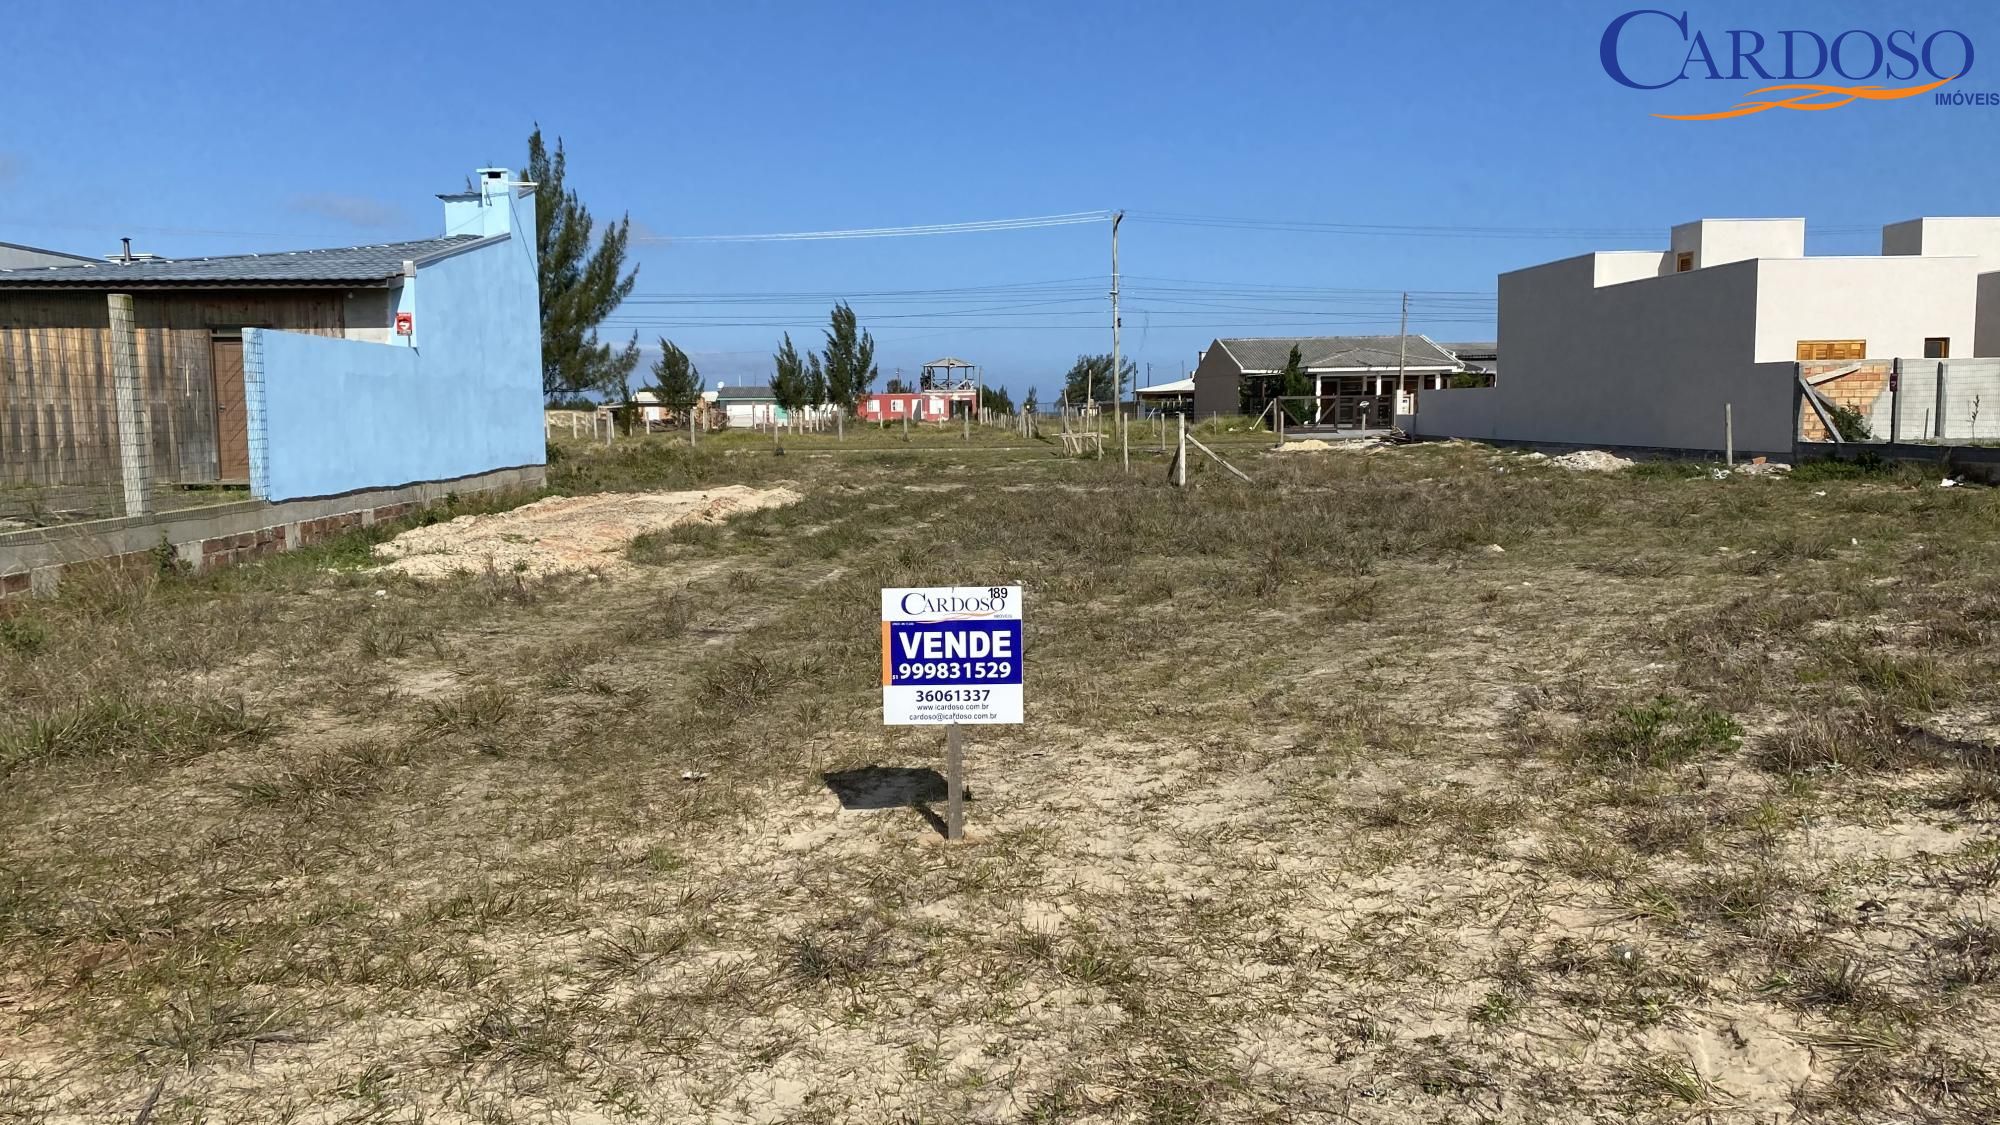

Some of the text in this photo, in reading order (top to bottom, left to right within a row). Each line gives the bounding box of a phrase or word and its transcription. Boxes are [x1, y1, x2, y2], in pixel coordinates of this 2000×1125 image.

[988, 587, 1008, 599] 189
[899, 630, 1012, 659] VENDE
[899, 662, 1011, 679] 999831529
[915, 690, 990, 702] 36061337
[916, 703, 990, 711] www.icardoso.com.br
[909, 713, 998, 721] cardoso@icardoso.com.br
